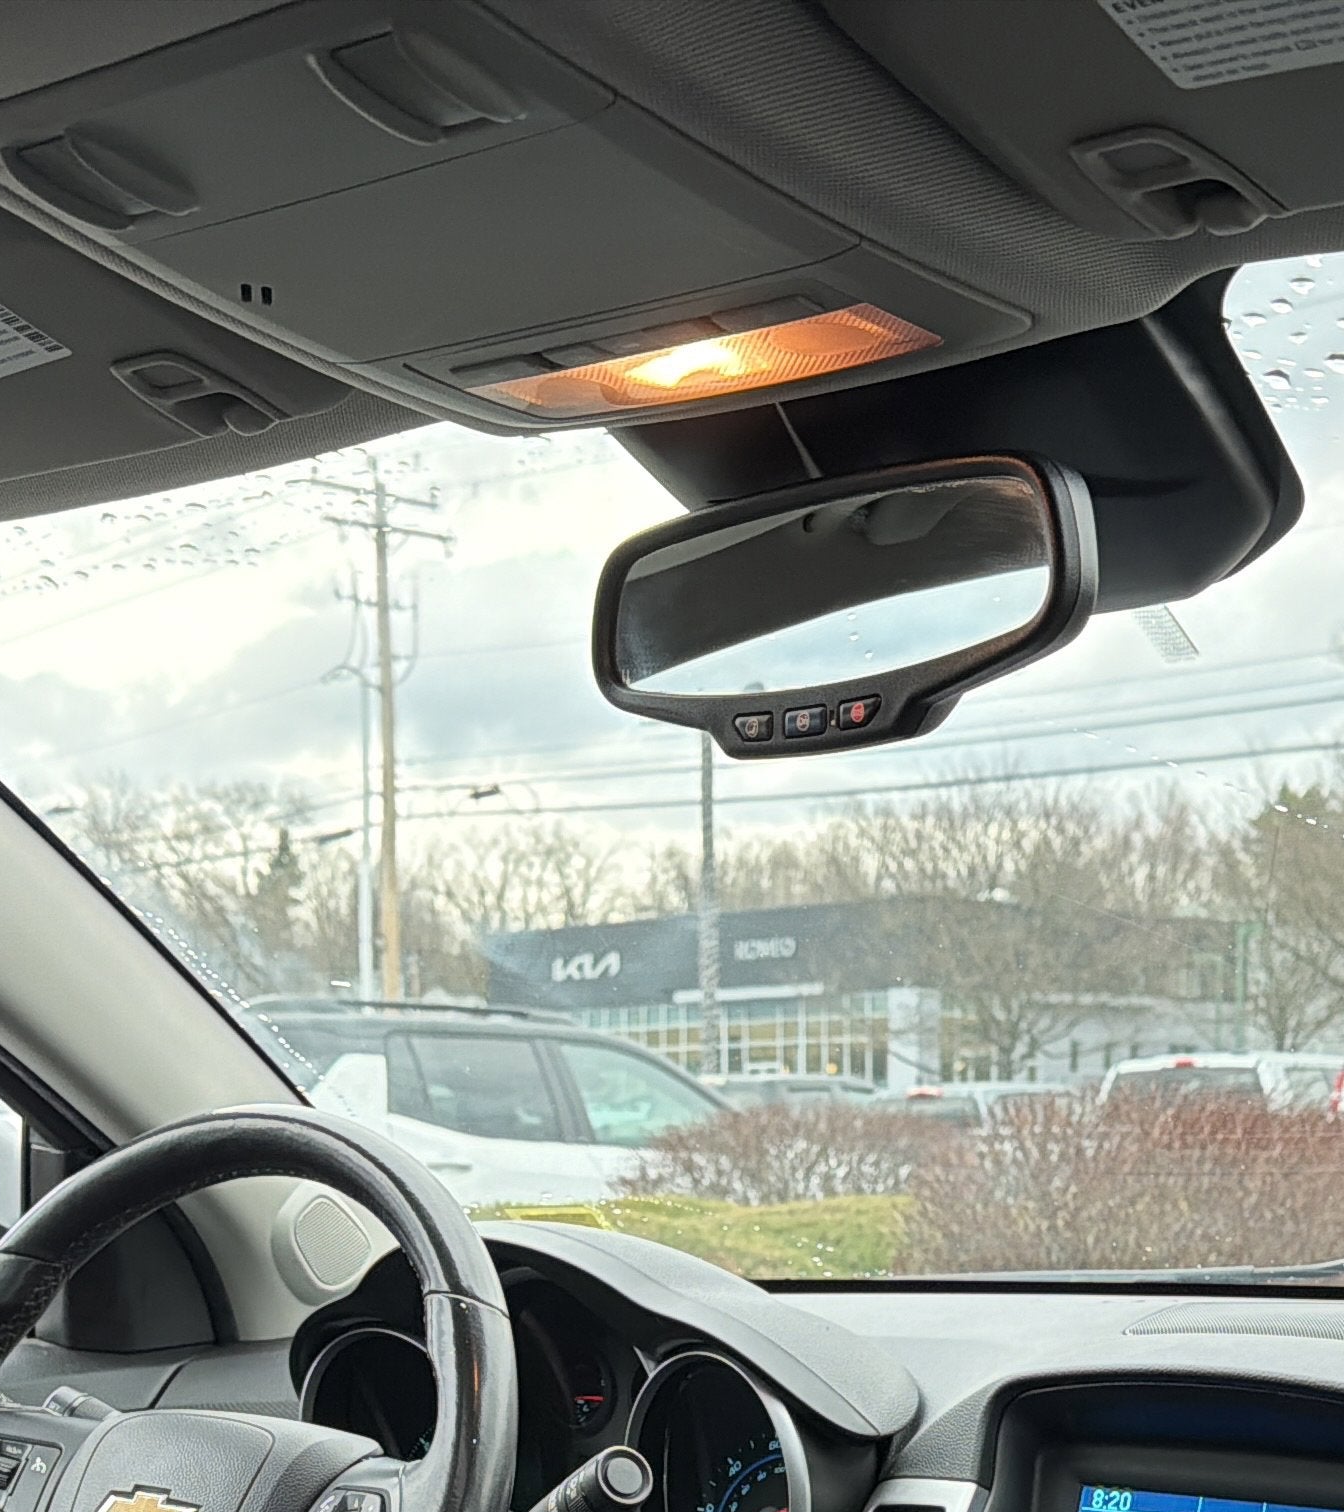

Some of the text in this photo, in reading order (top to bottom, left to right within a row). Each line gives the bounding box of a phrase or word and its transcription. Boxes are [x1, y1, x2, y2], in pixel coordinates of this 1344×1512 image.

[551, 950, 621, 982] KIA
[728, 1461, 742, 1477] 40
[1092, 1489, 1132, 1512] 8:20
